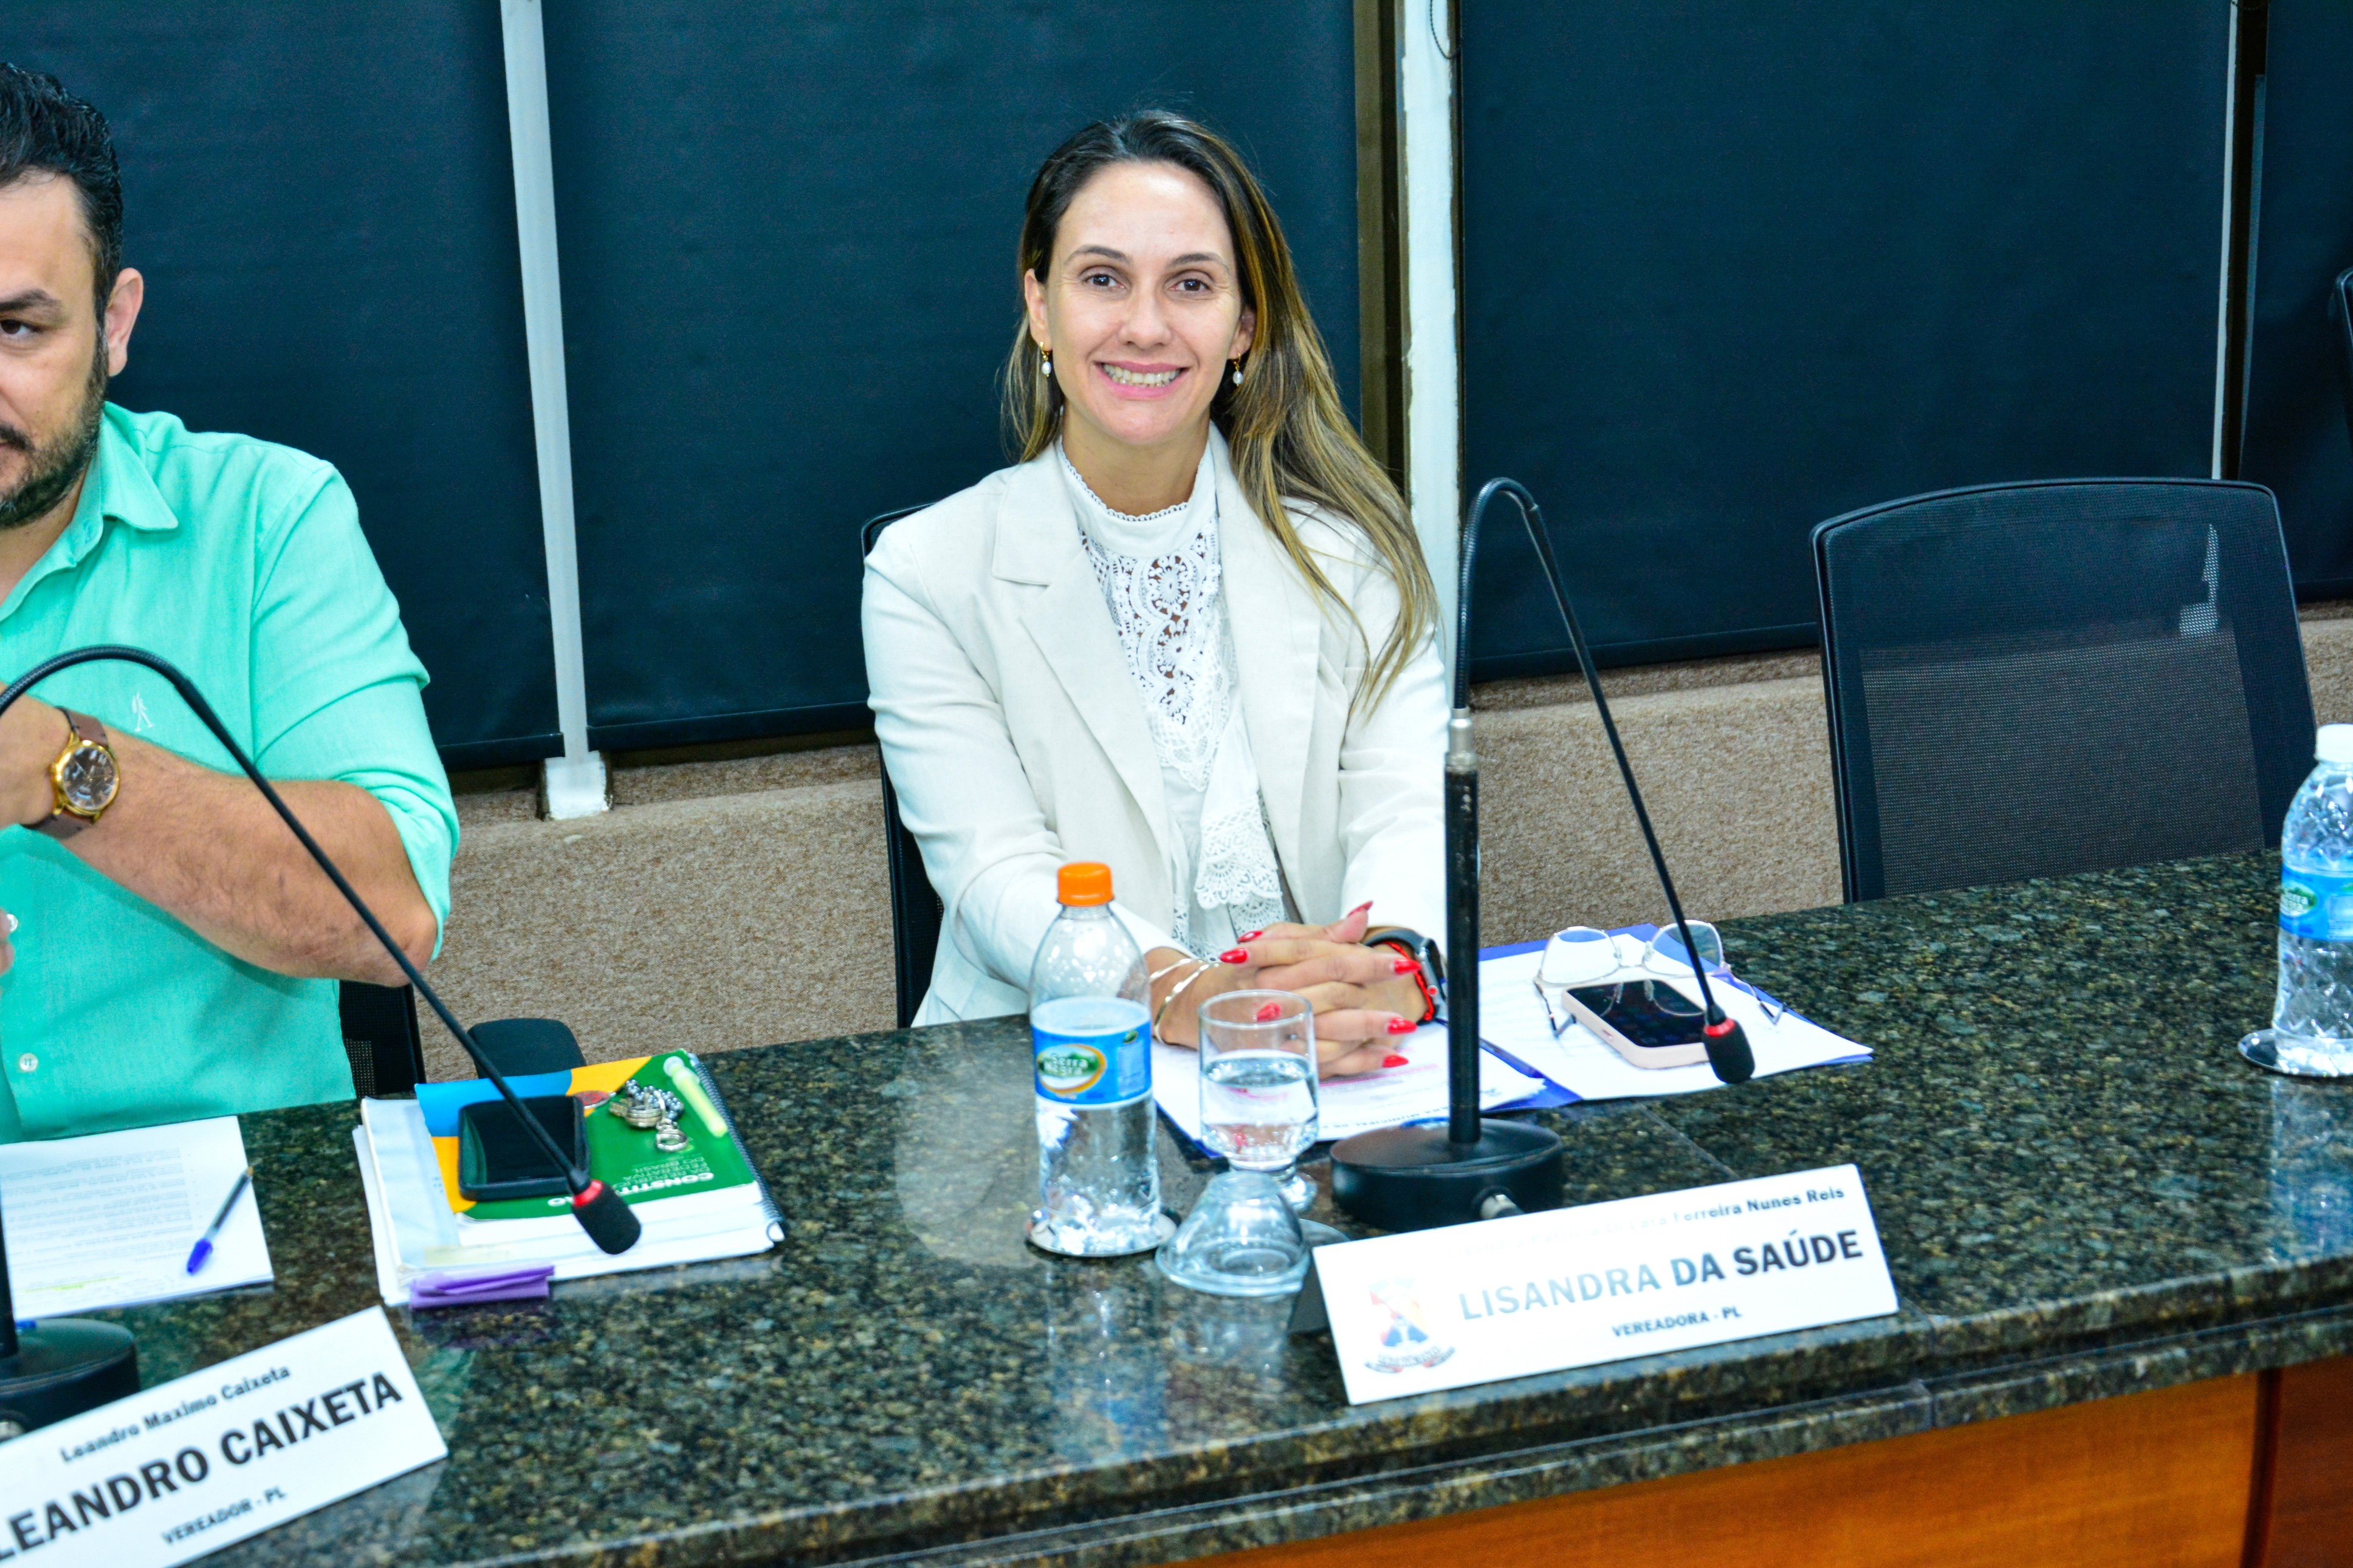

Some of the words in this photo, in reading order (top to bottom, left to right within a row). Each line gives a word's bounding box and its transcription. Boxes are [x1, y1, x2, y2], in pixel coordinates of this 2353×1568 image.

[1051, 1054, 1088, 1069] Serra
[1747, 1195, 1802, 1211] Nunes
[1805, 1186, 1845, 1203] Reis
[1458, 1264, 1661, 1321] LISANDRA
[1670, 1253, 1725, 1286] DA
[1733, 1230, 1863, 1276] SAÚDE
[1611, 1310, 1709, 1337] VEREADORA
[1722, 1305, 1742, 1320] PL
[60, 1424, 140, 1462] Leandro
[221, 1365, 290, 1400] Caixeta
[220, 1371, 403, 1466] CAIXETA
[160, 1498, 253, 1544] VEREADOR
[264, 1485, 287, 1505] PL
